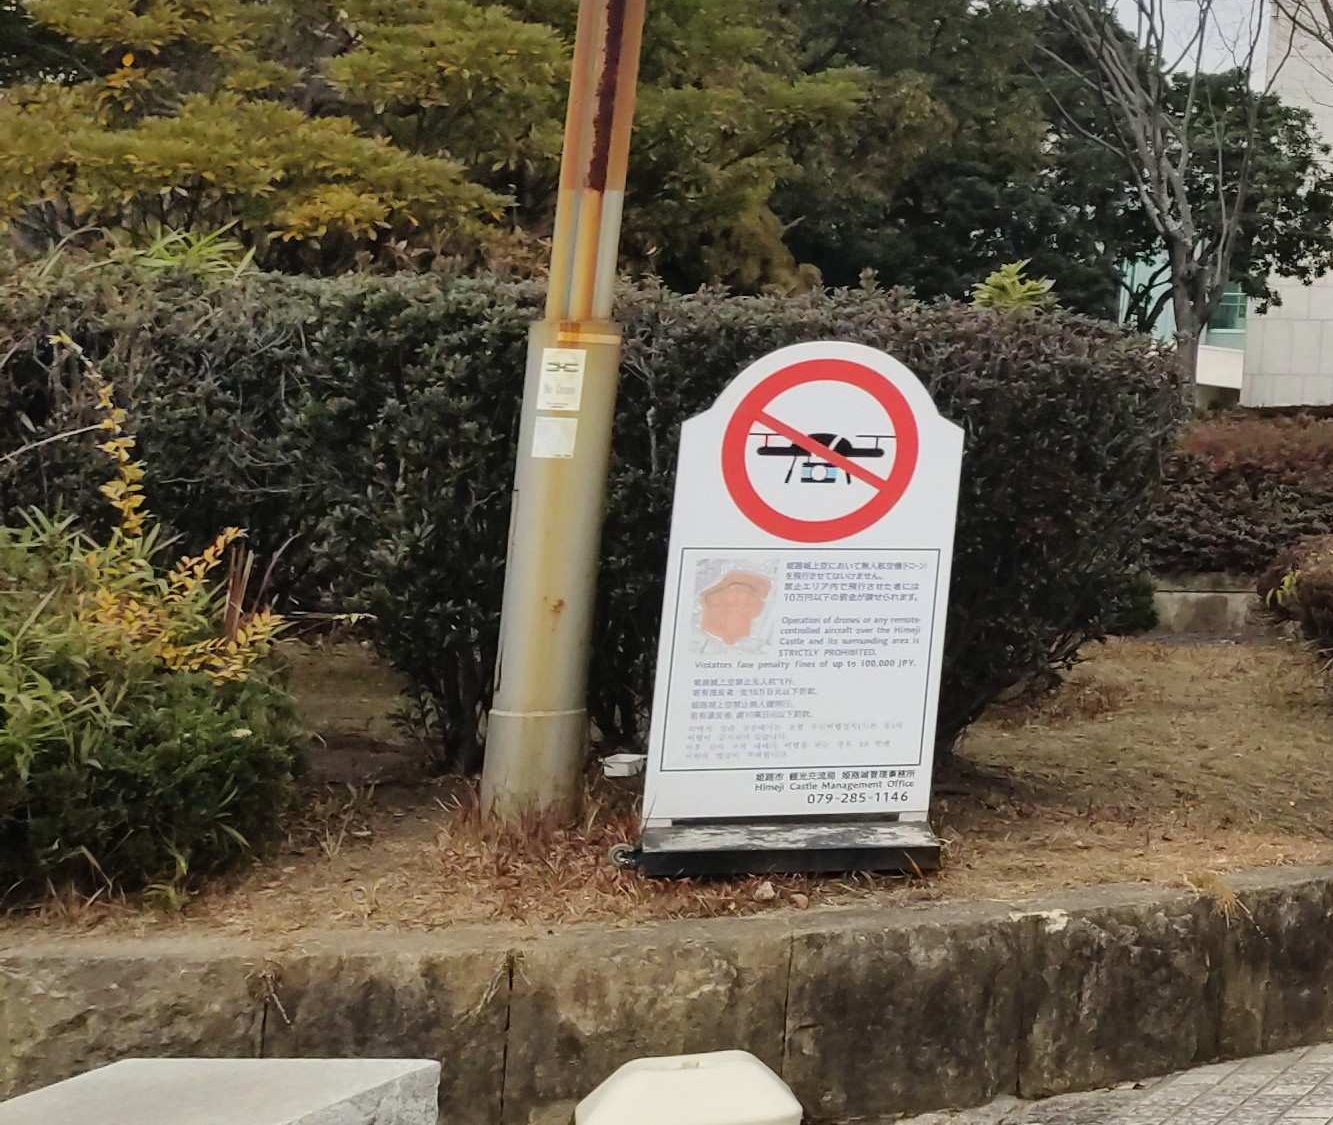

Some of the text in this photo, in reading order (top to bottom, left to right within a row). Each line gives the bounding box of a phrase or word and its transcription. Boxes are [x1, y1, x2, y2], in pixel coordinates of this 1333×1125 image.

[823, 616, 832, 624] of
[873, 618, 889, 626] any
[780, 626, 821, 635] controlled
[823, 626, 852, 634] aircraft
[876, 626, 890, 634] the
[894, 626, 921, 636] Himeji
[779, 637, 805, 645] Castle
[808, 637, 824, 645] and
[778, 649, 819, 657] STRICTLY
[695, 660, 733, 668] Violators
[736, 660, 754, 668] face
[757, 660, 790, 670] penalty
[794, 660, 815, 668] fines
[819, 660, 828, 668] of
[832, 661, 844, 670] up
[847, 660, 856, 668] to
[755, 779, 915, 793] Himeji Castle Management Office
[807, 791, 909, 804] 079-285-1146
